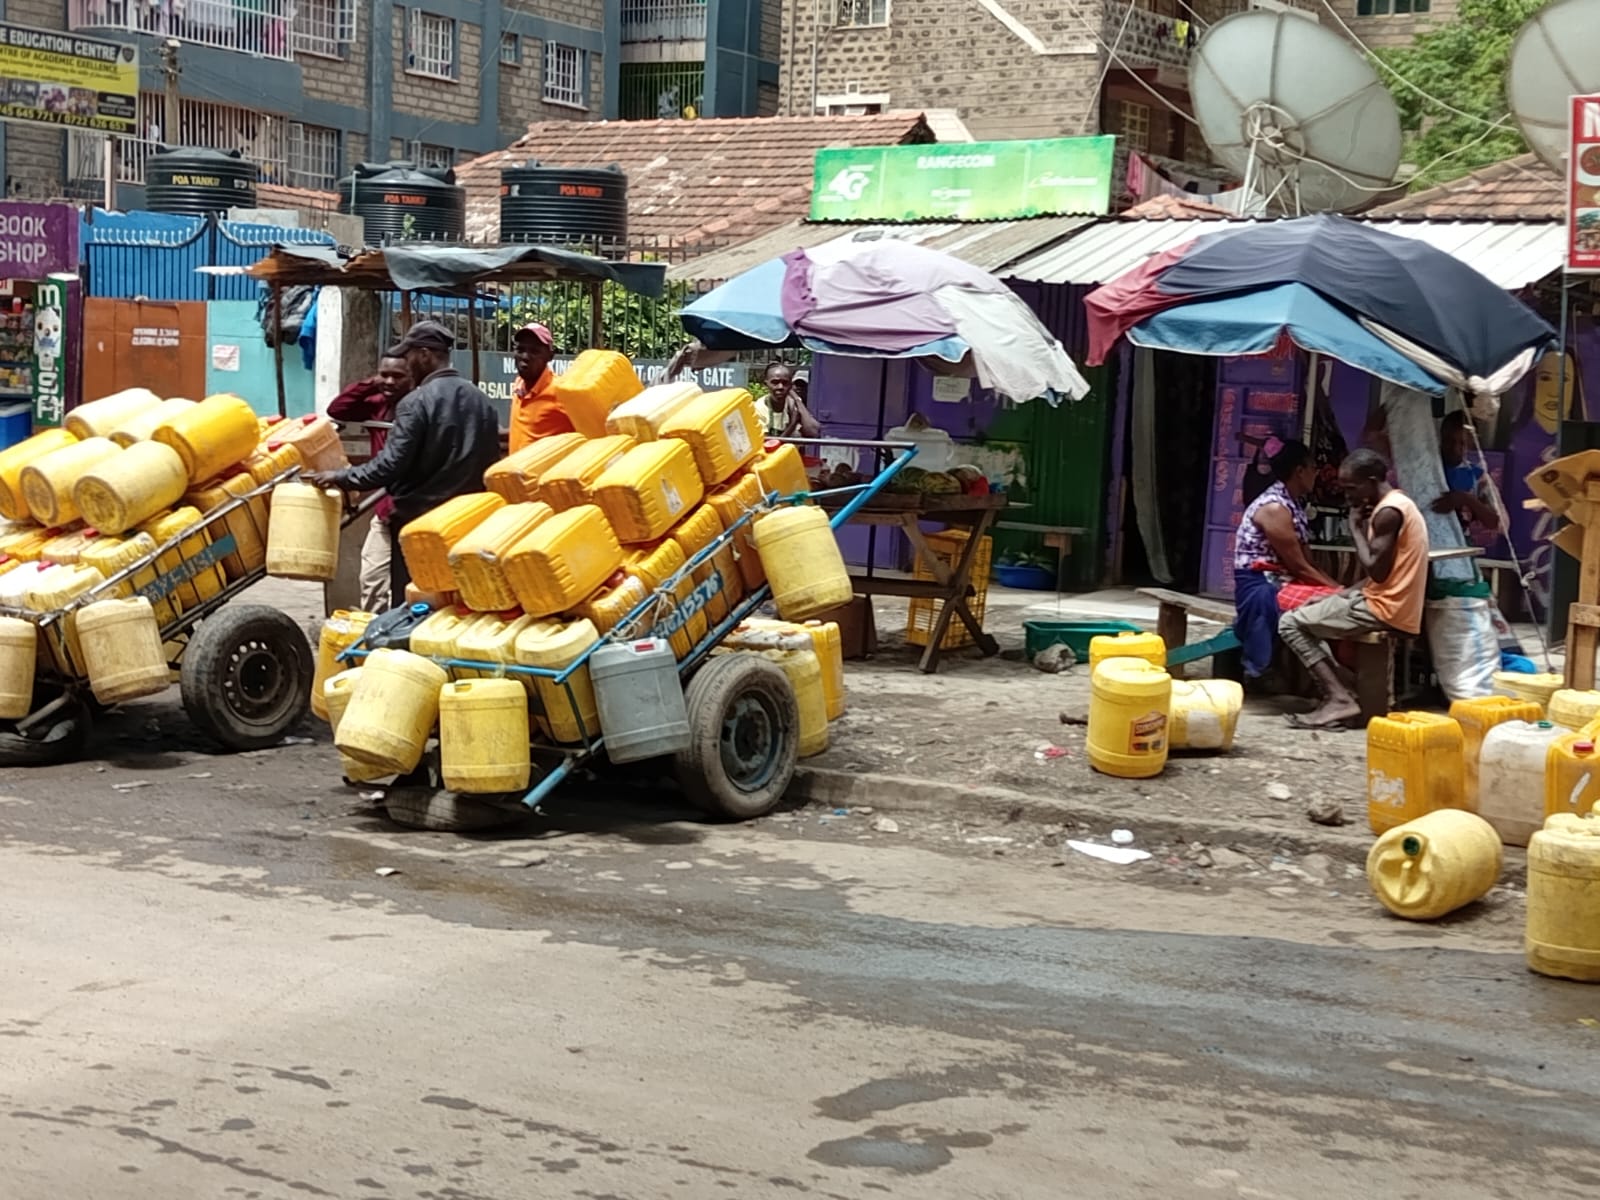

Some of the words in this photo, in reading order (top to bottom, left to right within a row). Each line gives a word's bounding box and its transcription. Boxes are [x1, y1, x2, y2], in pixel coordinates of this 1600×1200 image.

[10, 29, 72, 53] EDUCATION
[75, 41, 117, 62] CENTRE
[21, 51, 31, 59] OF
[34, 53, 75, 67] ACADEMIC
[37, 110, 54, 121] 771
[675, 366, 699, 384] HIS
[703, 367, 735, 387] GATE
